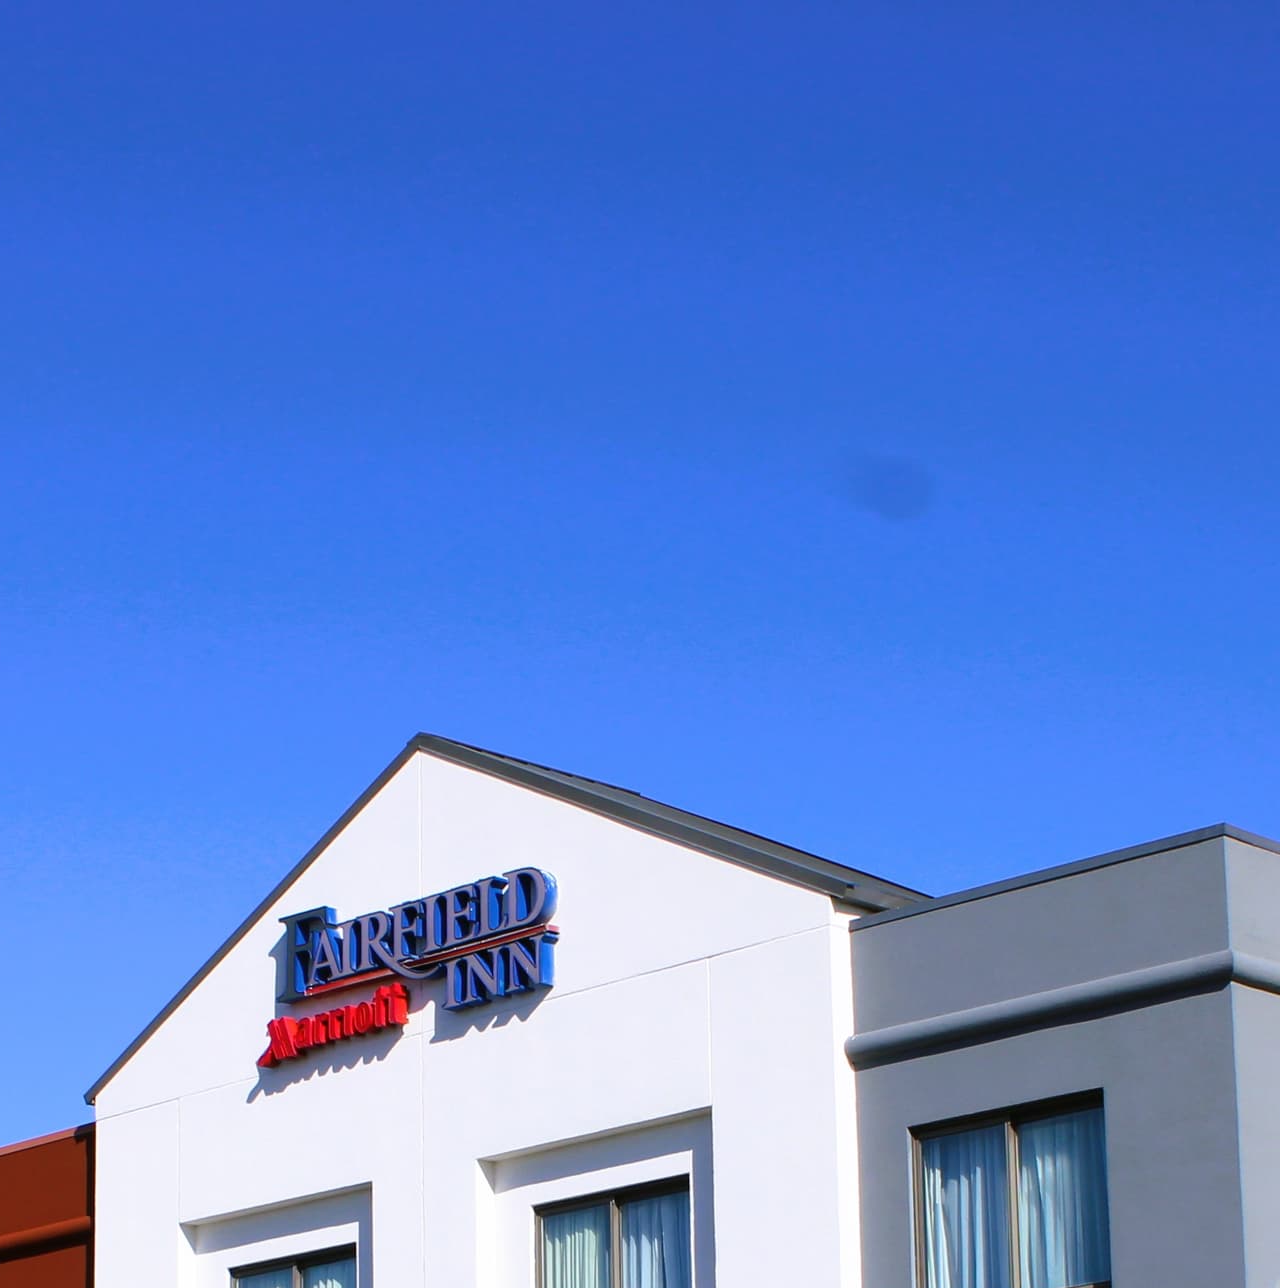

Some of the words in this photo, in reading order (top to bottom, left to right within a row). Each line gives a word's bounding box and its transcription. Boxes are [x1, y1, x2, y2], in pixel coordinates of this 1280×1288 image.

[278, 866, 558, 1003] FAIRFIELD
[442, 932, 559, 1011] INN
[256, 983, 410, 1067] Marriott
